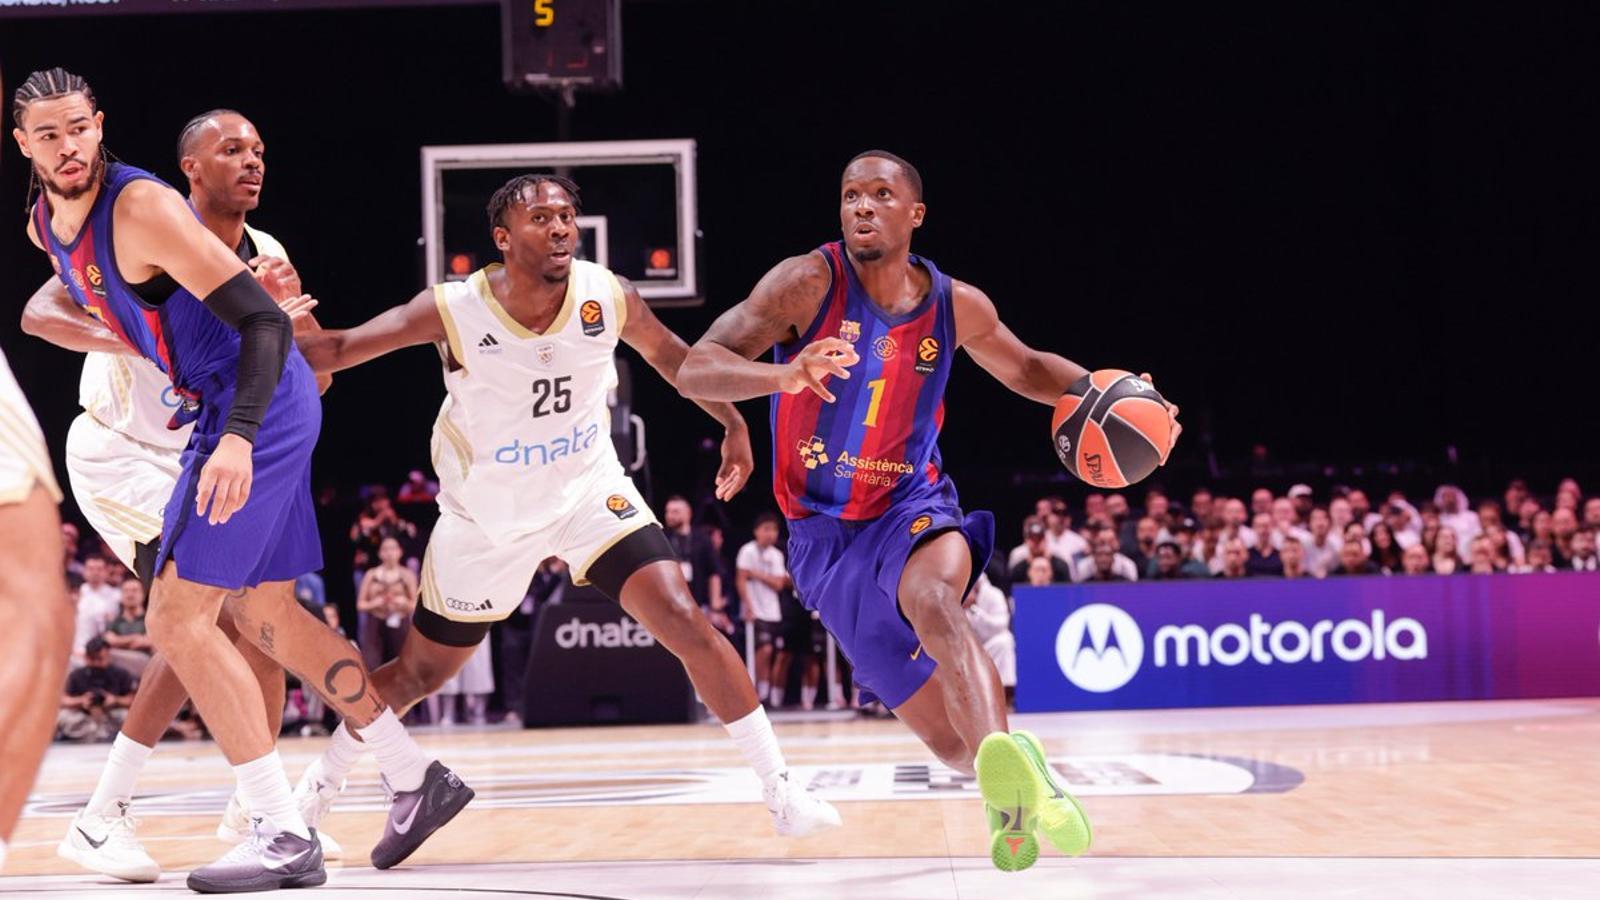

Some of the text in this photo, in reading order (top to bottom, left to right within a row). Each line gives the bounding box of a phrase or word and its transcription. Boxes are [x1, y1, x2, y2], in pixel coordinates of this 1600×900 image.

[532, 375, 572, 418] 25
[862, 378, 887, 428] 1
[495, 423, 598, 466] dnata
[836, 450, 914, 474] Assistència
[834, 464, 891, 487] Sanitària
[555, 617, 656, 649] dnata
[1153, 608, 1428, 668] motorola
